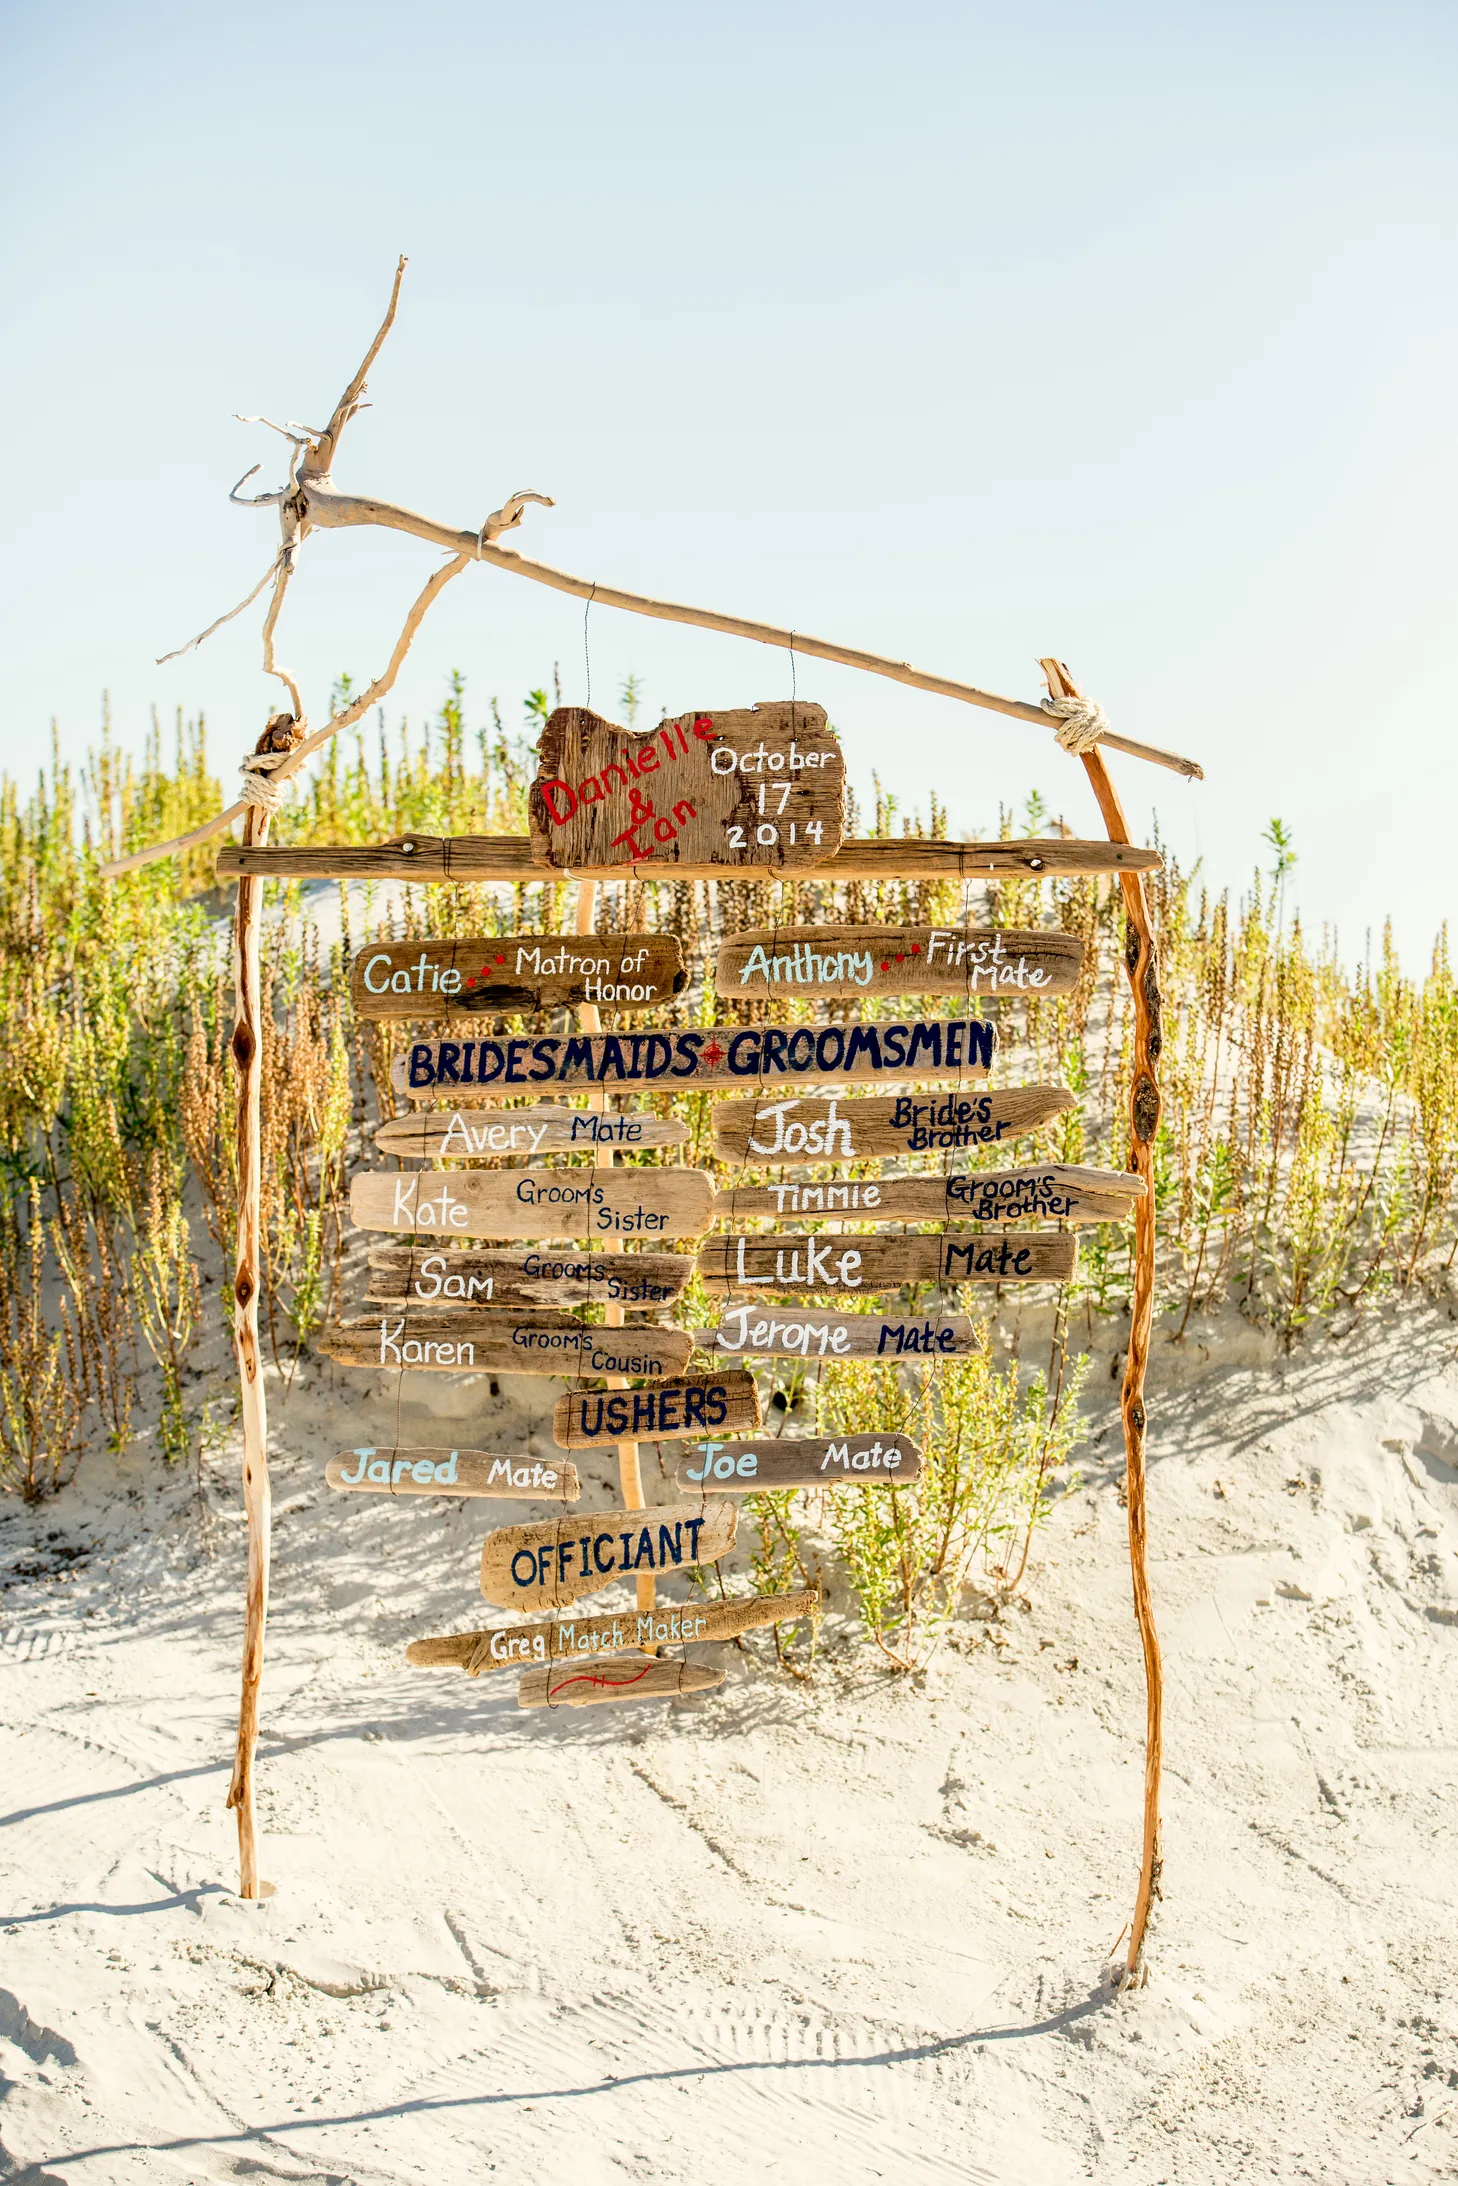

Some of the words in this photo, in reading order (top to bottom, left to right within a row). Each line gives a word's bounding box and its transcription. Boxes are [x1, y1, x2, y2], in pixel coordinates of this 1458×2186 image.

[541, 717, 718, 827] Danielle
[711, 742, 837, 776] October
[630, 787, 656, 825] &
[758, 782, 793, 815] 17
[610, 799, 698, 865] Ian
[727, 820, 824, 849] 2014
[515, 946, 611, 976] Matron
[620, 949, 651, 973] of
[739, 943, 875, 986] Anthony
[926, 931, 1007, 966] First
[363, 953, 462, 994] Catie
[585, 977, 658, 1002] Honor
[971, 961, 1053, 991] Mate
[408, 1033, 704, 1089] BRIDESMAIDS
[727, 1021, 994, 1075] GROOMSMEN
[749, 1099, 856, 1157] Josh
[889, 1097, 993, 1128] Bride's
[440, 1112, 548, 1155] Avery
[571, 1116, 643, 1143] Mate
[907, 1118, 1011, 1151] Brother
[392, 1178, 469, 1228] Kate
[516, 1178, 605, 1205] Groom's
[946, 1175, 1056, 1202] Groom's
[596, 1207, 670, 1231] Sister
[972, 1195, 1080, 1221] Brother
[414, 1256, 494, 1299] Sam
[736, 1236, 863, 1287] Luke
[944, 1241, 1033, 1277] Mate
[607, 1276, 675, 1301] Sister
[379, 1318, 475, 1366] Karen
[512, 1326, 593, 1351] Groom's
[716, 1305, 851, 1356] Jerome
[877, 1324, 957, 1355] Mate
[591, 1351, 663, 1375] Cousin
[580, 1386, 728, 1437] USHERS
[340, 1447, 459, 1484] Jared
[486, 1458, 558, 1489] Mate
[686, 1443, 759, 1480] Joe
[820, 1441, 903, 1471] Mate
[511, 1517, 706, 1588] OFFICIANT
[490, 1630, 546, 1662] Greg
[558, 1621, 625, 1652] Match
[637, 1613, 707, 1644] Maker
